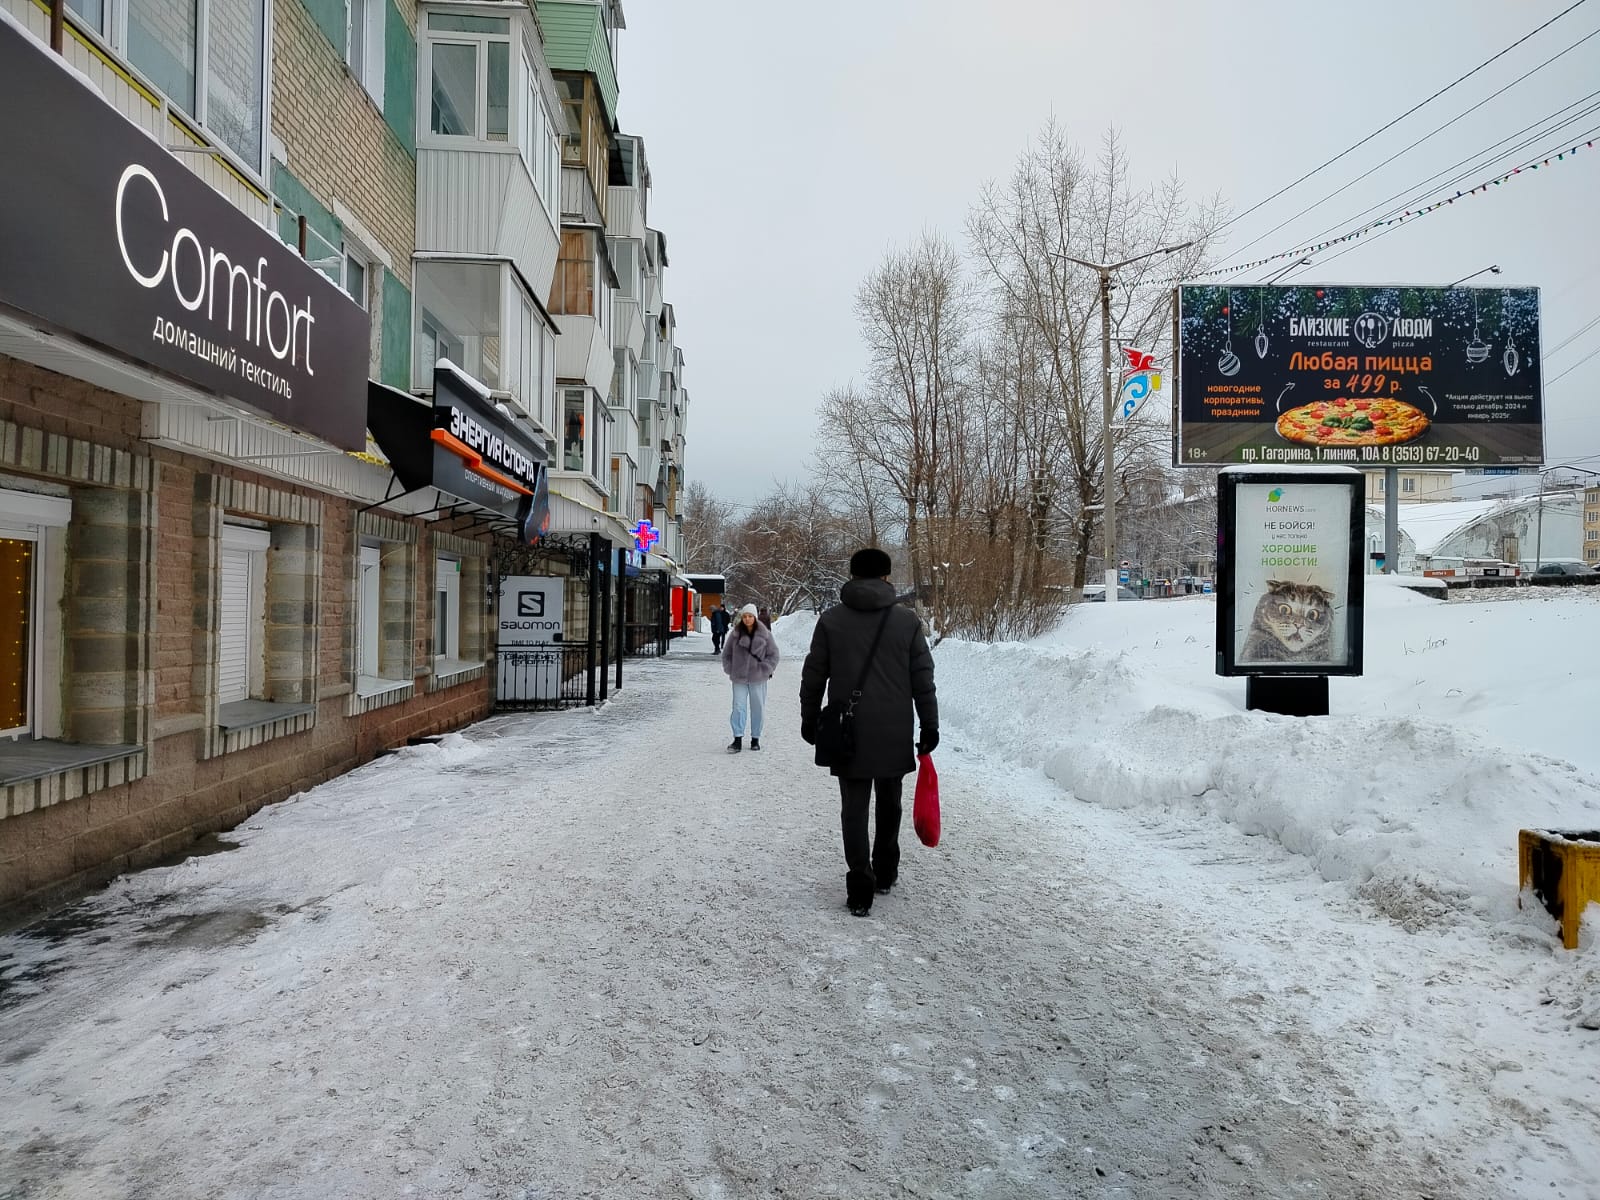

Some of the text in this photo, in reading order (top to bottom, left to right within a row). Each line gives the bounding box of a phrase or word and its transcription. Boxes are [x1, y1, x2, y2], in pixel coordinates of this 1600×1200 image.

[115, 163, 315, 377] Comfort
[1289, 317, 1433, 339] БЛИЗКИЕ ЛЮДИ
[1307, 340, 1350, 348] restaurant
[1392, 340, 1415, 348] pizza
[153, 316, 293, 400] домашний текстиль
[1289, 351, 1433, 375] Любая пицца
[1323, 378, 1341, 390] за
[1345, 373, 1386, 394] 499
[1207, 385, 1262, 394] новогодние
[1203, 397, 1265, 406] корпоративы,
[1211, 409, 1260, 418] праздники
[450, 406, 535, 484] ЭНЕРГИЯ СПОРТА
[1187, 447, 1208, 459] 18+
[1242, 447, 1259, 463] пр.
[1261, 446, 1314, 463] Гагарина,
[1315, 446, 1321, 460] 1
[1322, 448, 1360, 463] линия,
[1382, 446, 1389, 461] 8
[1392, 446, 1424, 462] (3513)
[1265, 505, 1305, 513] HORNEWS
[1264, 520, 1315, 530] НЕ БОЙСЯ!
[1262, 544, 1317, 553] ХОРОШИЕ
[1261, 557, 1318, 566] НОВОСТИ!
